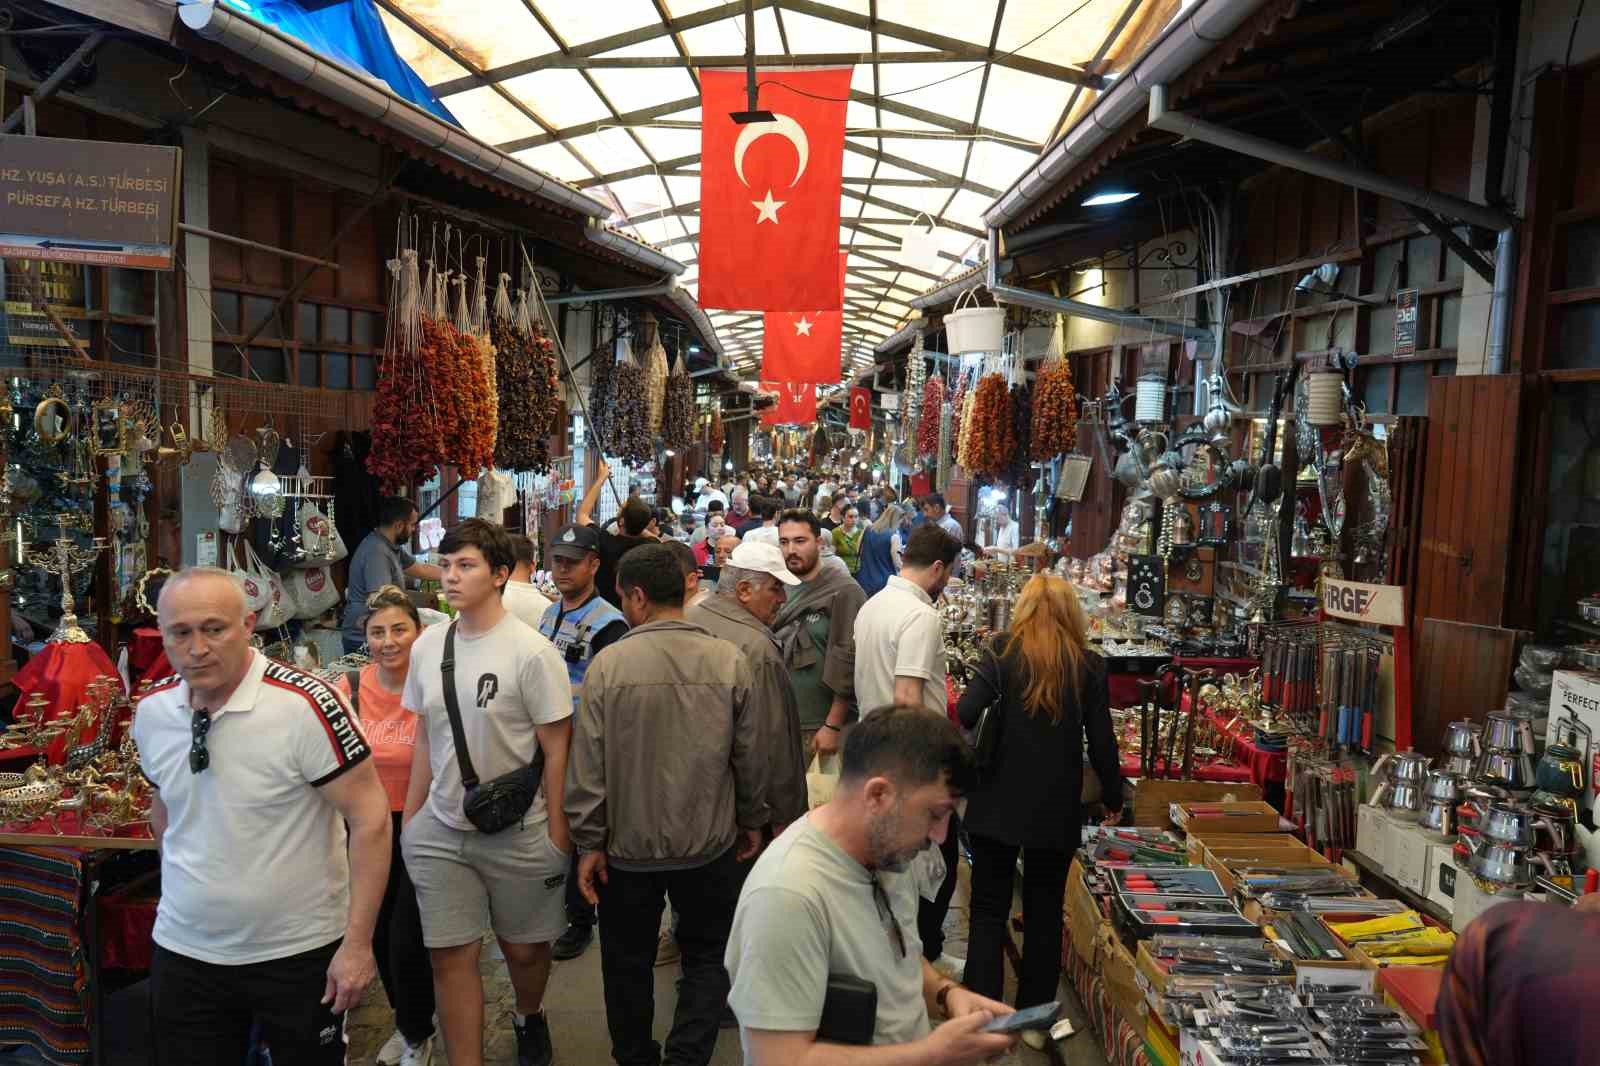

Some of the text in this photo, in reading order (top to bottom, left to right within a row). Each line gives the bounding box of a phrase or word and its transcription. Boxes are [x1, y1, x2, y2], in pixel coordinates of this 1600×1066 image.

[1, 169, 24, 182] HZ.
[76, 199, 97, 211] HZ.
[264, 661, 364, 761] TYLE STREET STYLE
